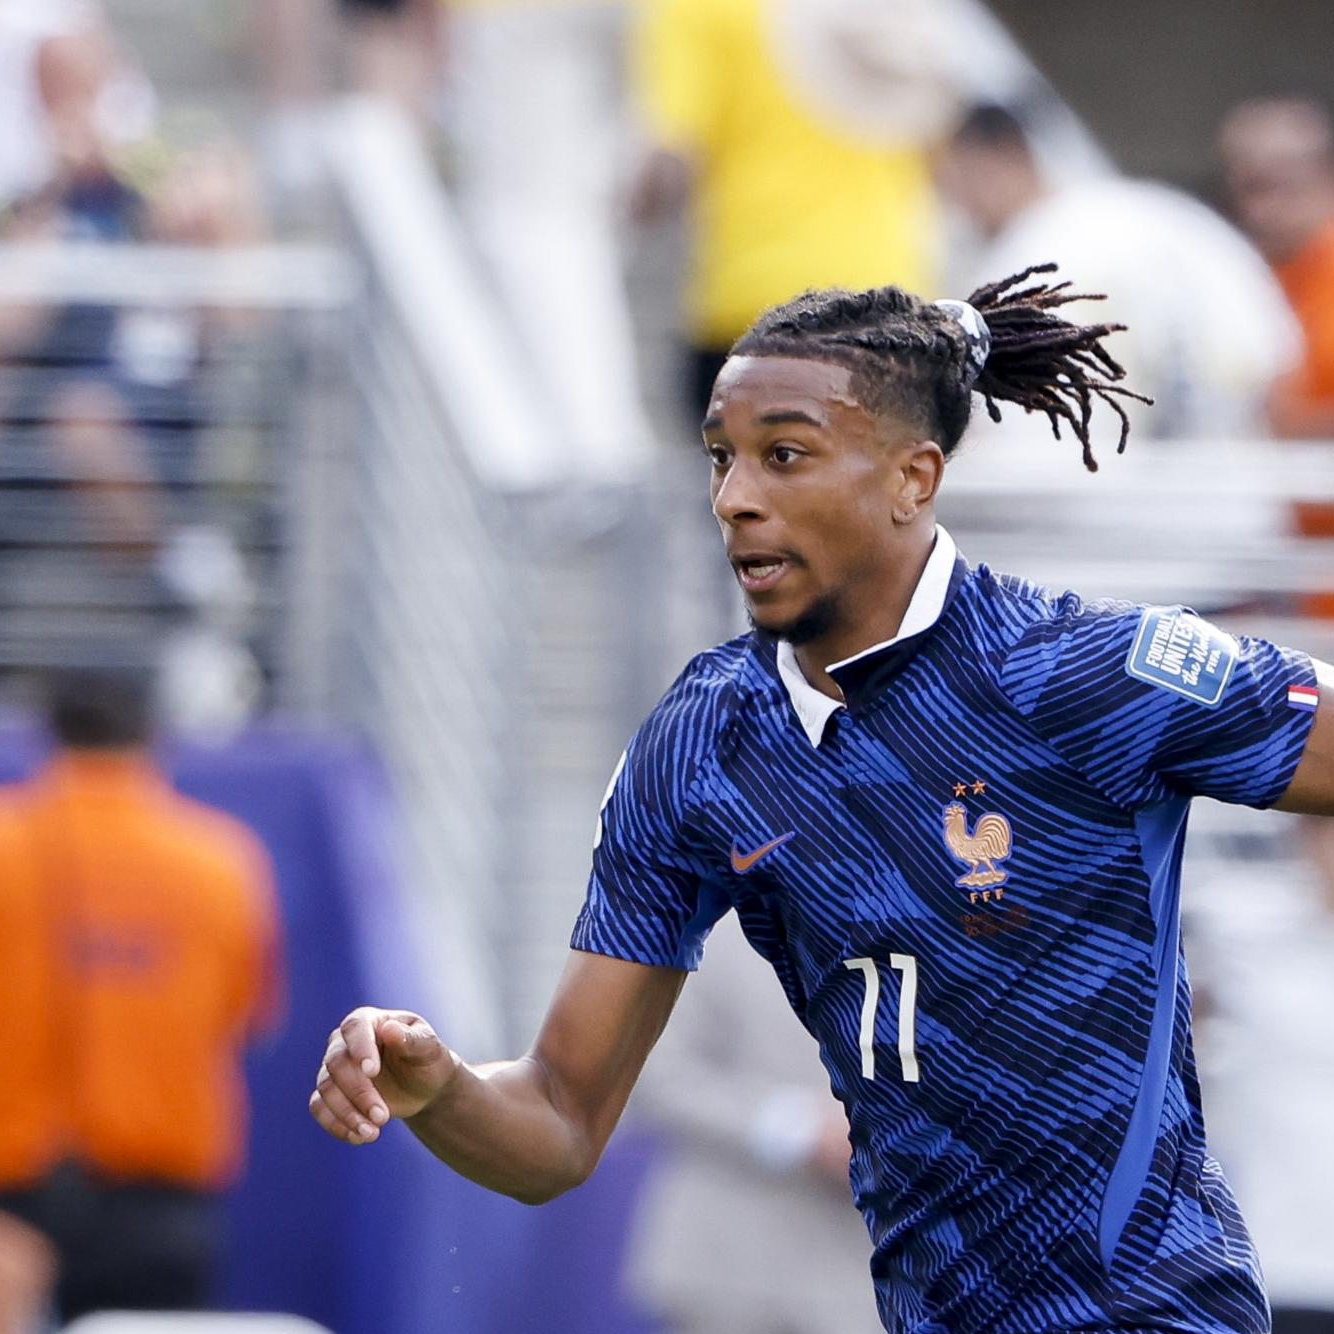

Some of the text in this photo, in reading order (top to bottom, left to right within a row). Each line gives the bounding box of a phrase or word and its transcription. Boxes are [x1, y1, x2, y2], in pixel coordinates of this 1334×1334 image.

[1145, 614, 1176, 667] FOOTBALL
[1160, 619, 1195, 676] UNITES
[1205, 650, 1222, 674] FIFA
[1181, 660, 1203, 687] the
[843, 953, 919, 1083] 11
